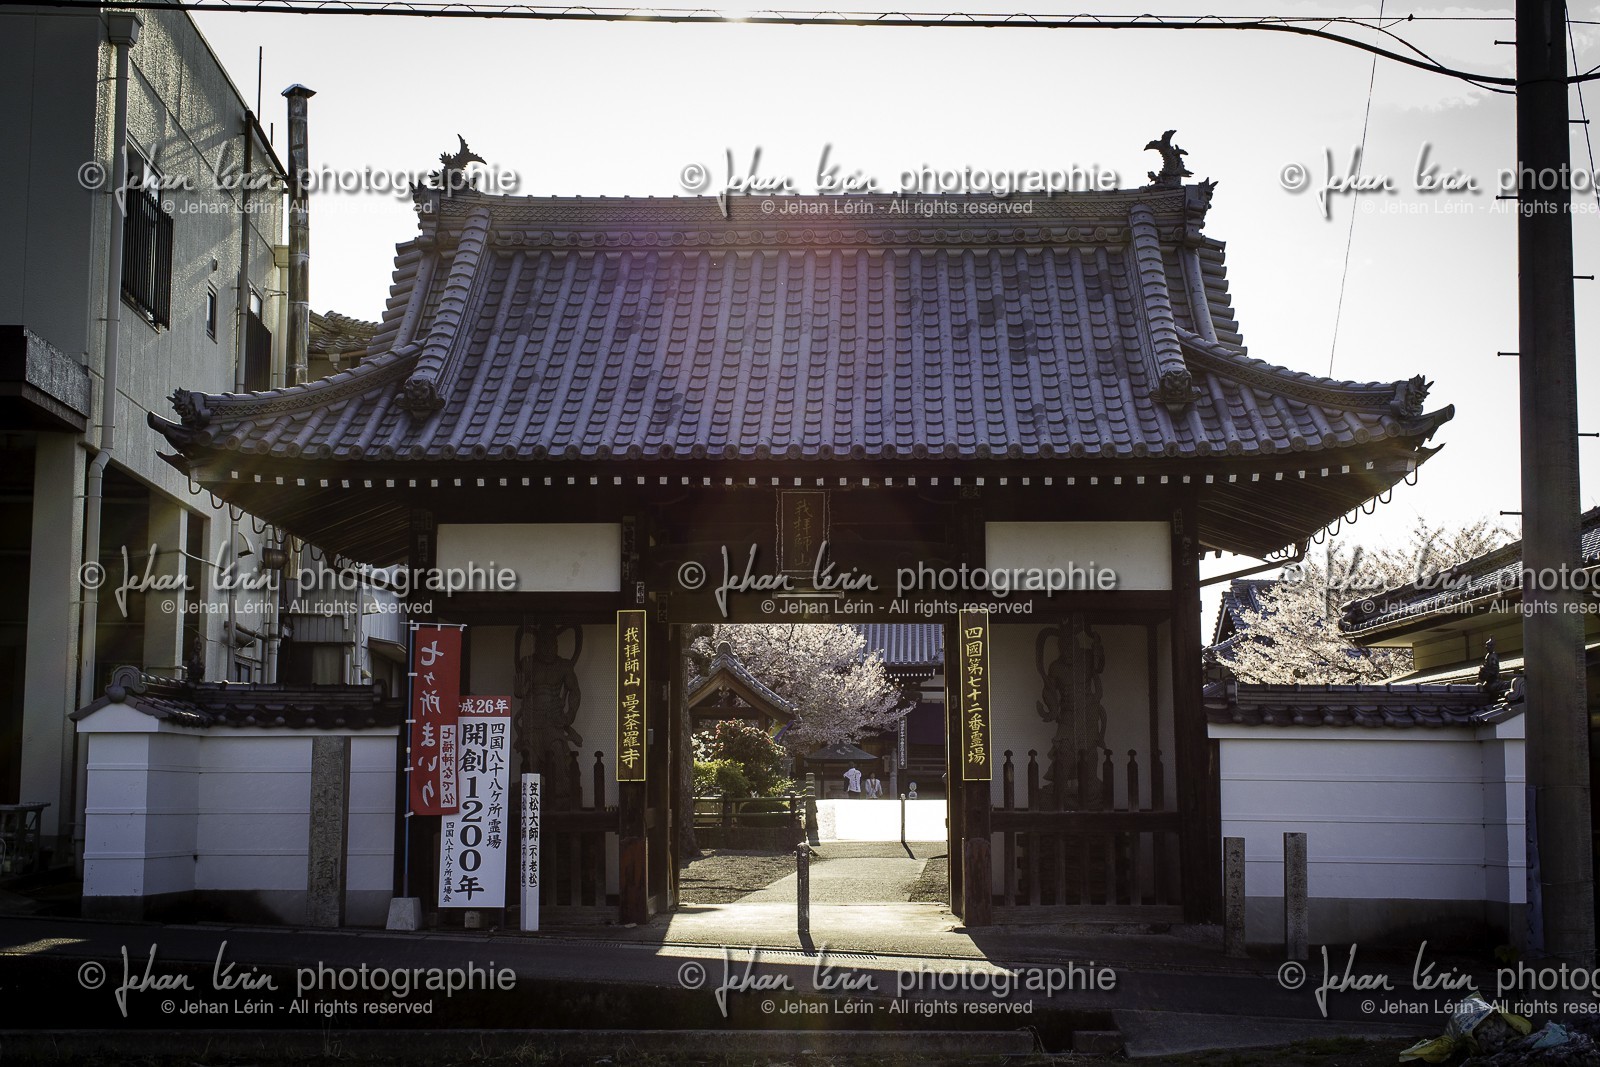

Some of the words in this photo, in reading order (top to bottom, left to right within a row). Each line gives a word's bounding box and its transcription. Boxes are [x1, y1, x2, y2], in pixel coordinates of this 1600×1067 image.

[458, 698, 509, 714] 成26年
[454, 721, 489, 901] 開創1200年
